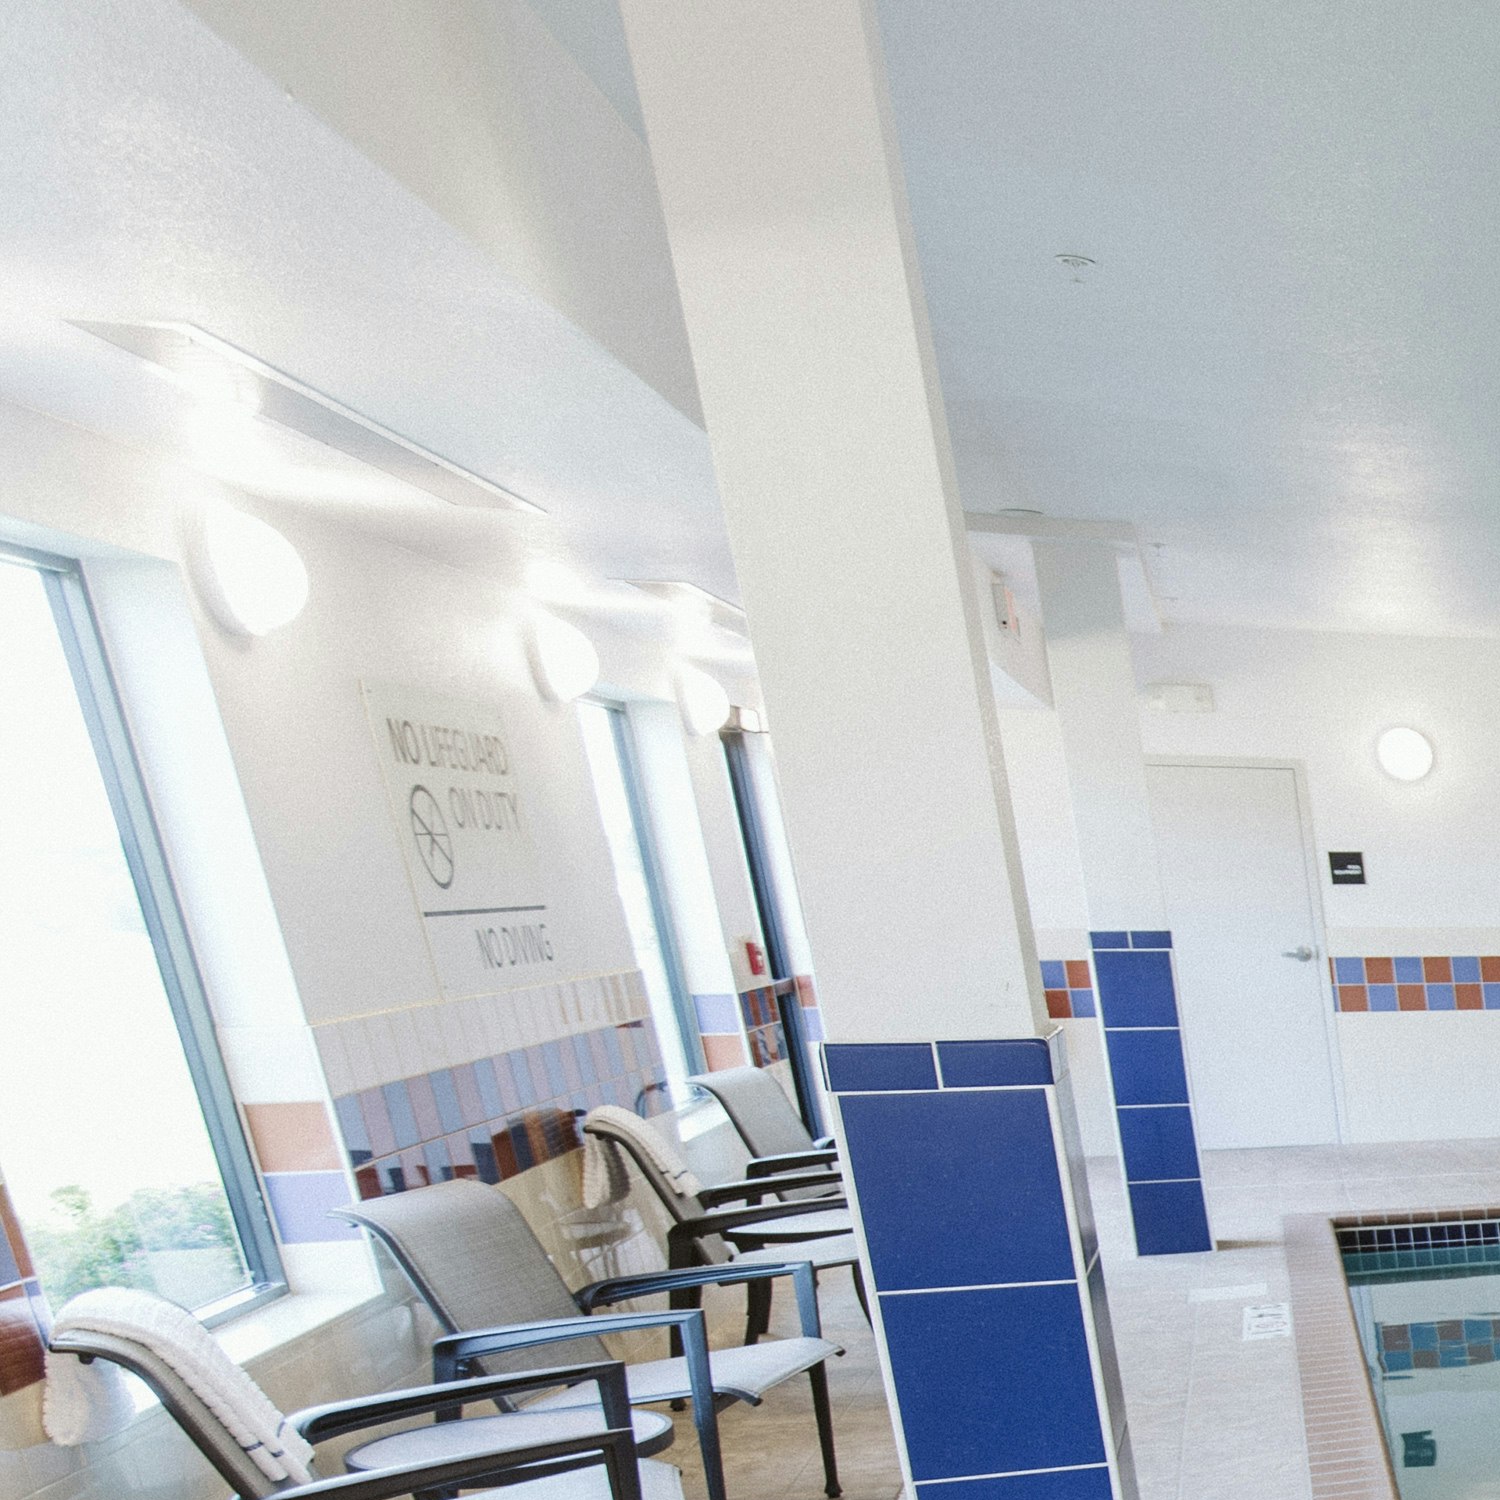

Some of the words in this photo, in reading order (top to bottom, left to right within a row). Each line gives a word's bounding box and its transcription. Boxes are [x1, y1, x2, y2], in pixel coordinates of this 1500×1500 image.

[386, 718, 420, 765] NO
[420, 724, 508, 776] LIFEGUARD
[448, 786, 478, 829] ON
[476, 789, 520, 831] DUTY
[475, 927, 503, 969] NO
[501, 923, 553, 966] DIVING
